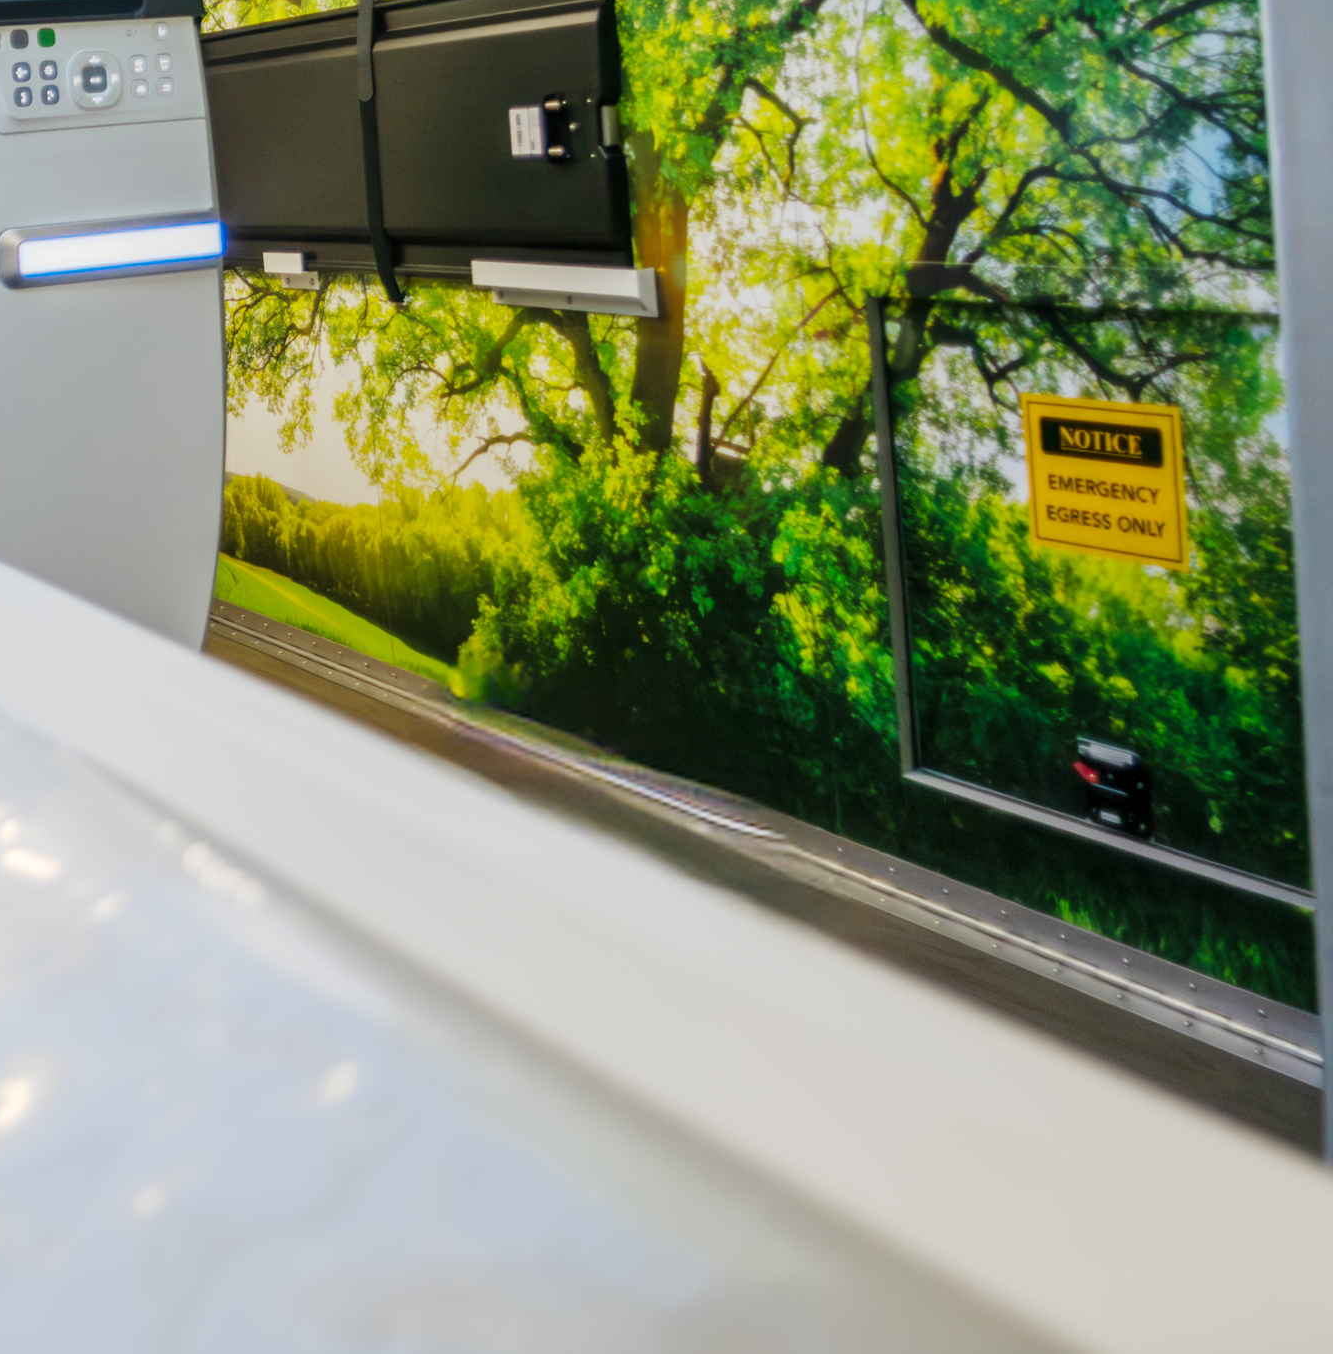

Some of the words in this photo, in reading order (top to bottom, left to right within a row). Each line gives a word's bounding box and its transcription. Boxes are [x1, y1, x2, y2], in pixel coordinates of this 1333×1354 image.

[1059, 425, 1143, 456] NOTICE
[1048, 474, 1160, 505] EMERGENCY
[1046, 504, 1112, 530] EGRESS
[1117, 516, 1166, 538] ONLY
